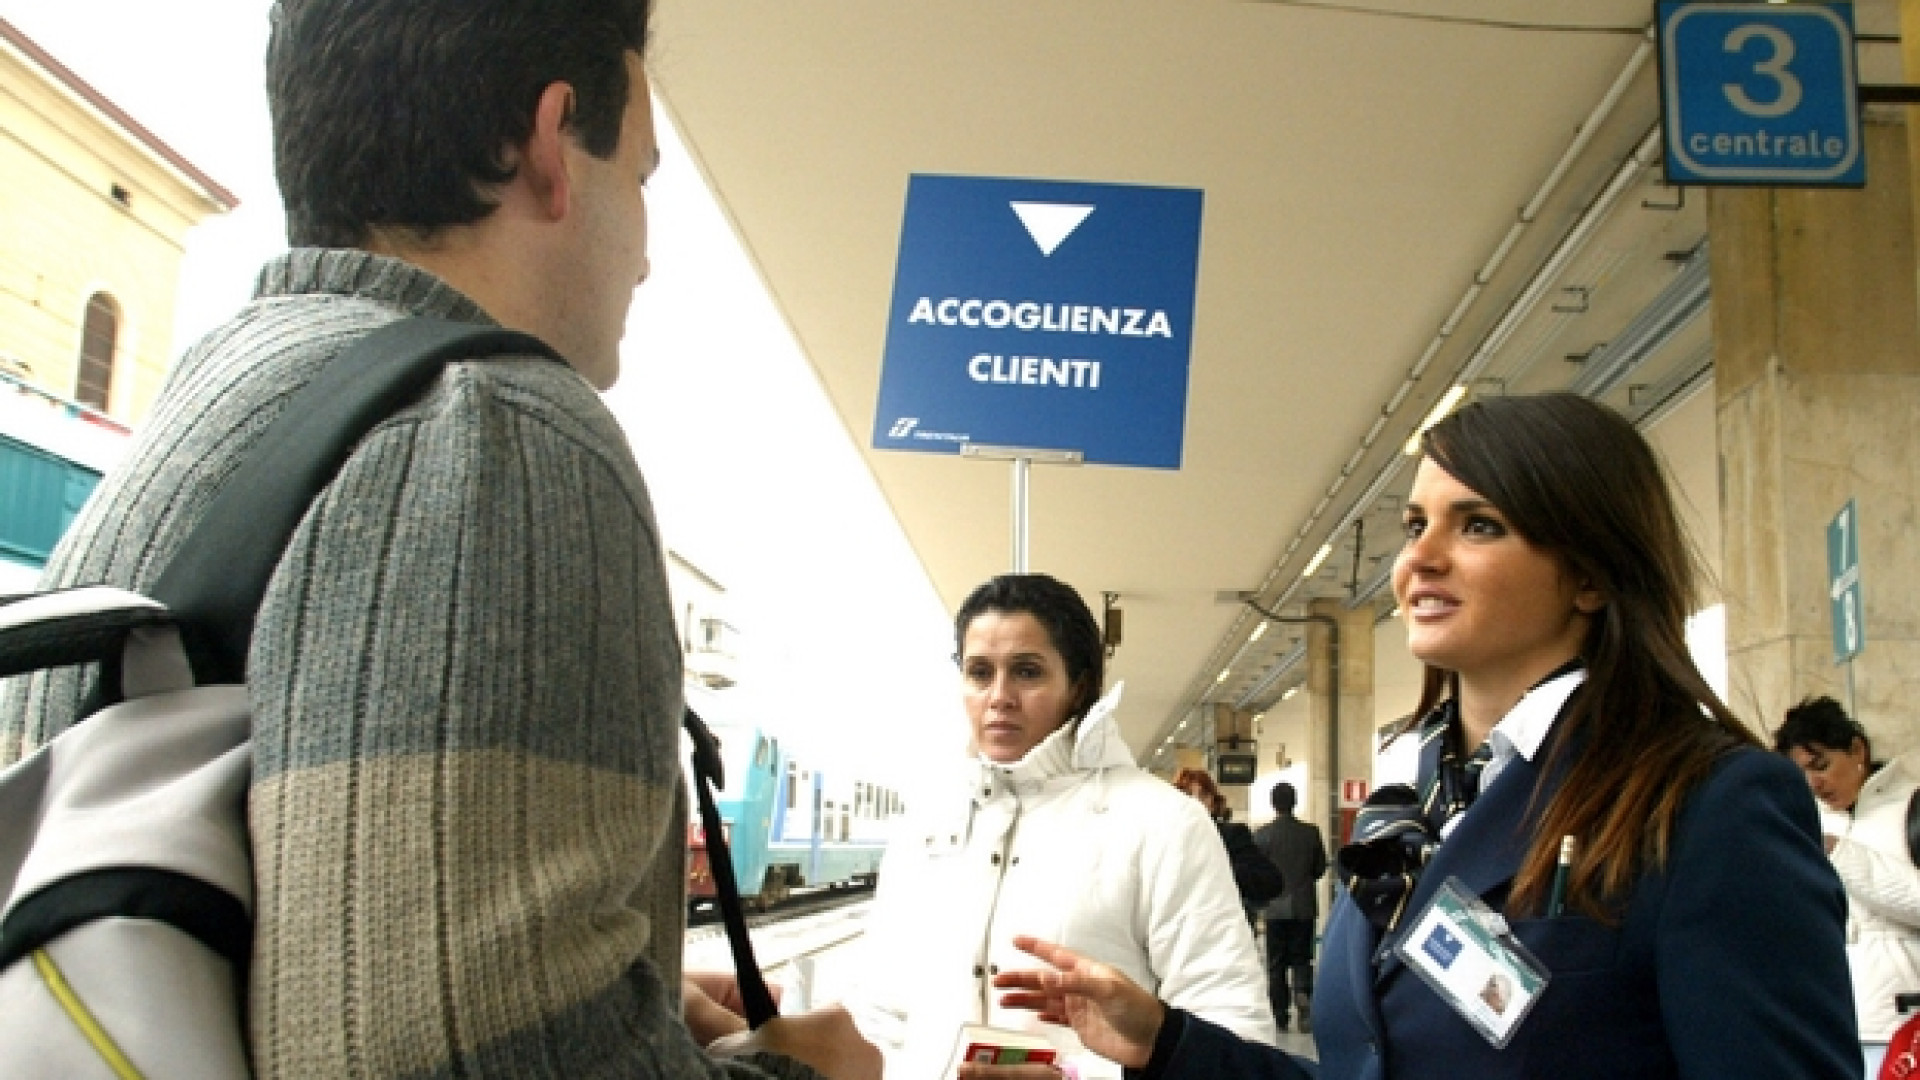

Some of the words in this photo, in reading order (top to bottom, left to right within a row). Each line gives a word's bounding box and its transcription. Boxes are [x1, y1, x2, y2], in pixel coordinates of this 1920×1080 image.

[1722, 24, 1803, 117] 3
[1690, 129, 1845, 158] centrale
[907, 296, 1173, 337] ACCOGLIENZA
[967, 353, 1101, 389] CLIENTI
